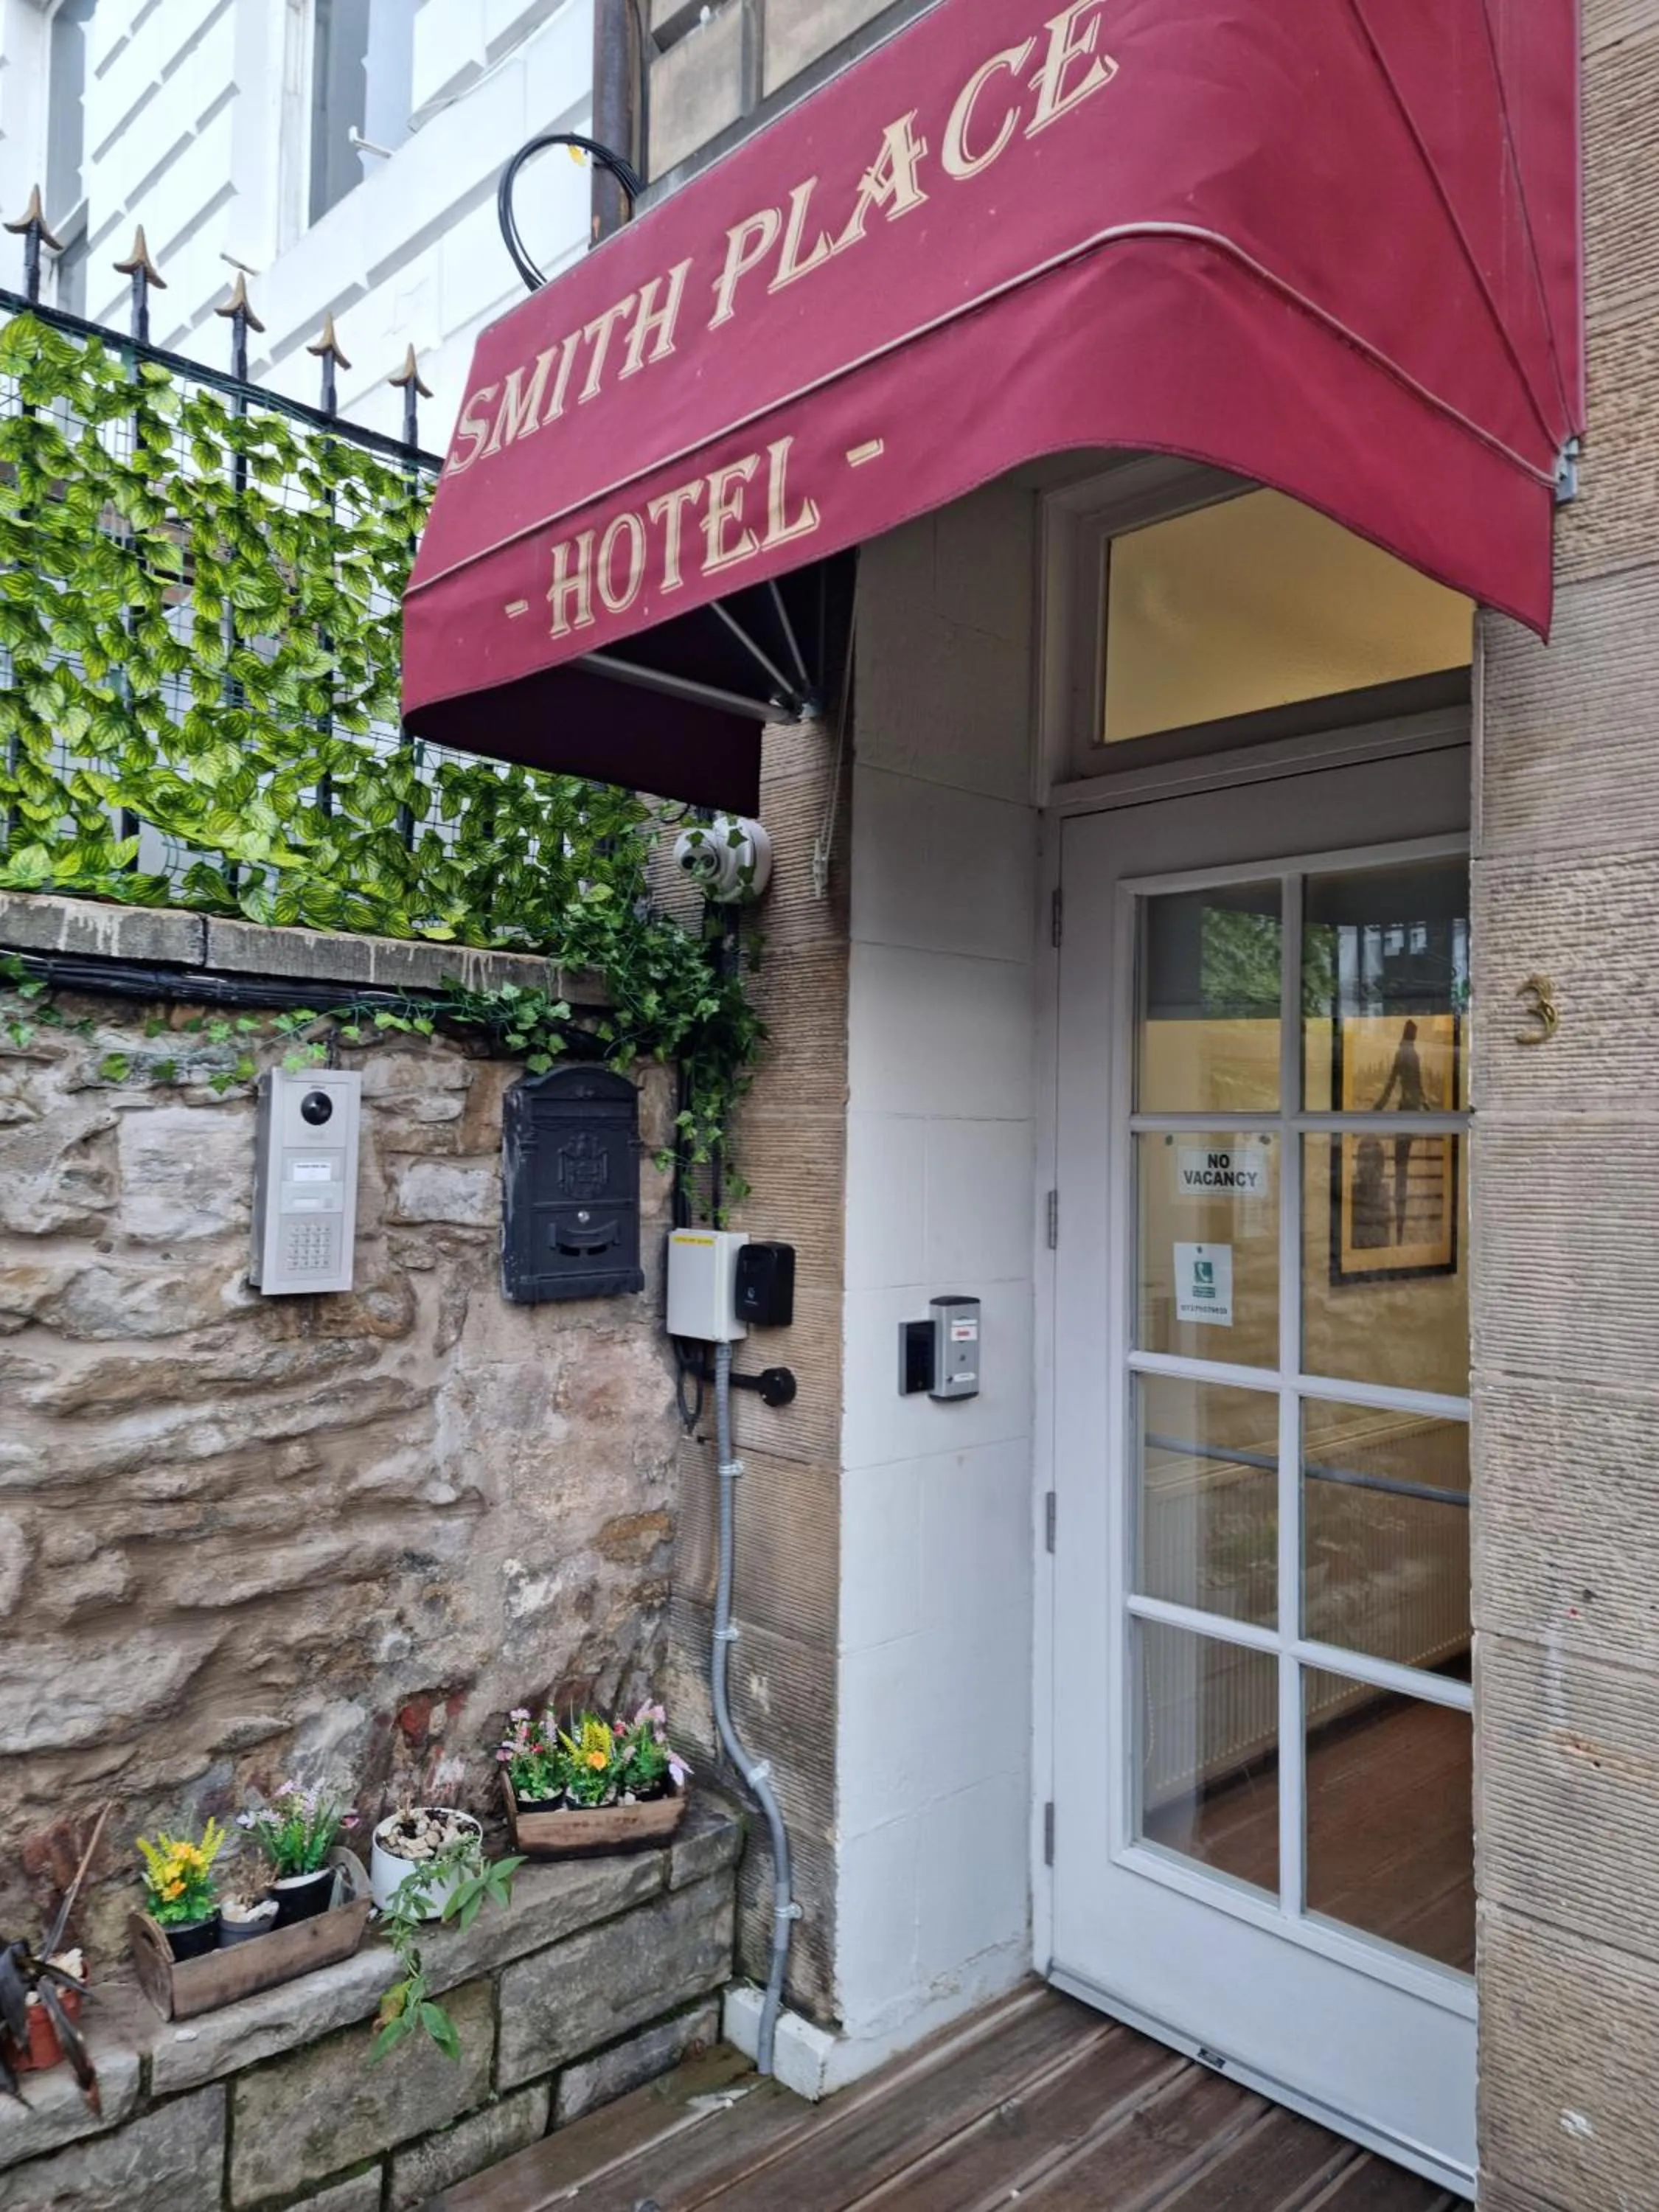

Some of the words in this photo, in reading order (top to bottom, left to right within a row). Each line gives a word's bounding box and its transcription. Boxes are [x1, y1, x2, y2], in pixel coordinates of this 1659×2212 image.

[446, 258, 693, 478] SMITH
[709, 0, 1119, 330] PLACE
[546, 436, 819, 639] HOTEL
[1516, 973, 1560, 1045] 3
[1183, 1170, 1257, 1186] VACANCY
[1208, 1153, 1230, 1169] NO
